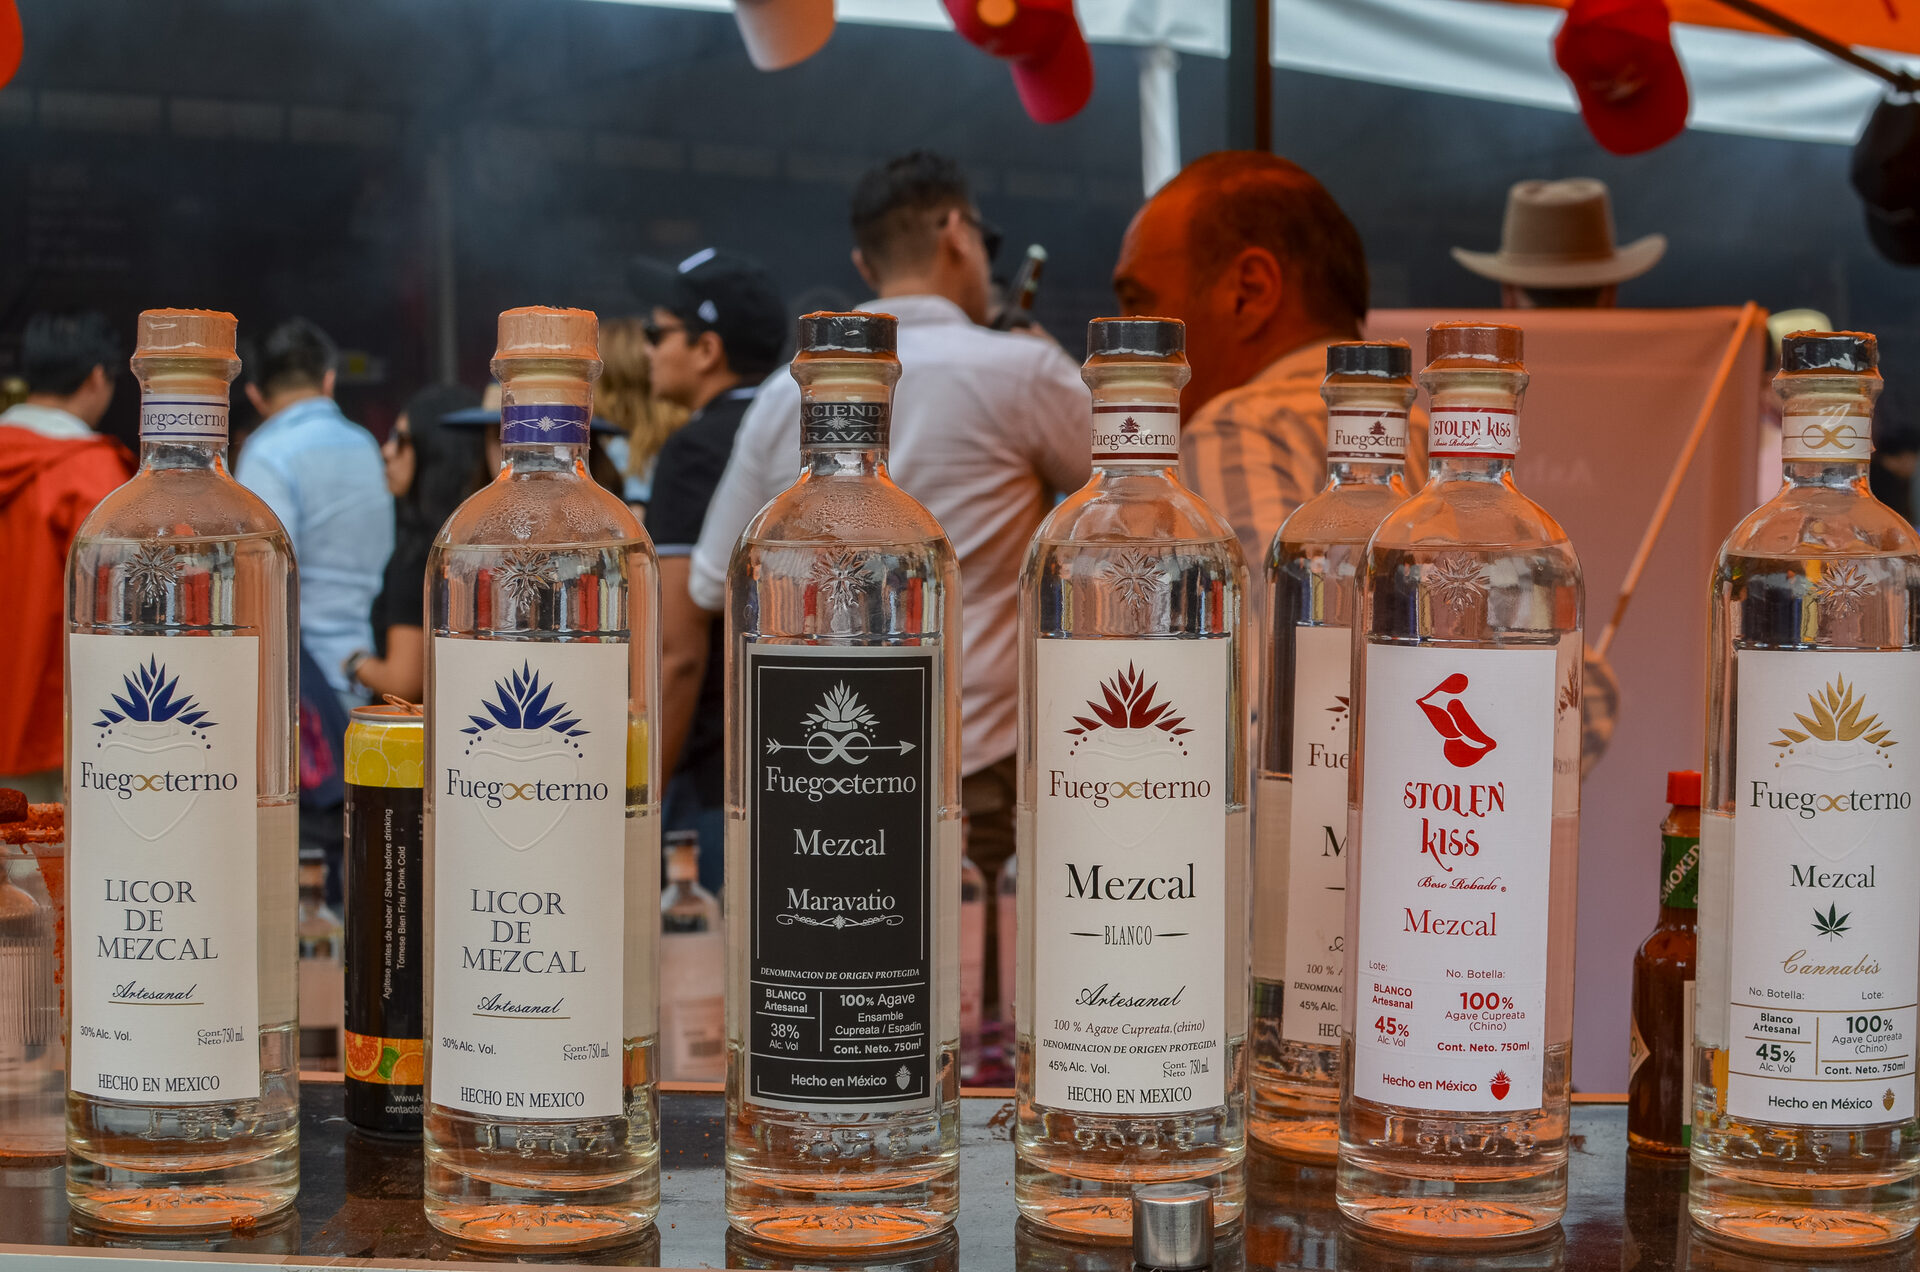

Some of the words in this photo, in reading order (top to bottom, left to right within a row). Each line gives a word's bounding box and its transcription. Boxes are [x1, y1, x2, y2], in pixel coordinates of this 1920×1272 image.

[1434, 419, 1481, 439] STOLEN
[1403, 781, 1505, 818] STOLEN
[384, 808, 394, 841] drinking
[793, 828, 886, 856] Mezcal
[384, 843, 393, 870] before
[397, 846, 406, 866] Cold
[384, 871, 393, 898] Shake
[397, 867, 406, 889] Drink
[1064, 862, 1197, 901] Mezcal
[1417, 875, 1448, 890] Beso
[1449, 876, 1502, 891] Robado
[1789, 864, 1876, 889] Mezcal
[104, 879, 197, 903] LICOR
[786, 887, 896, 911] Maravatio
[470, 888, 566, 915] LICOR
[124, 909, 163, 932] DE
[384, 904, 393, 929] beber
[397, 915, 406, 934] Bien
[1403, 907, 1497, 937] Mezcal
[384, 930, 393, 941] de
[490, 919, 532, 944] DE
[1104, 925, 1153, 946] BLANCO
[97, 935, 219, 961] MEZCAL
[384, 943, 393, 967] antes
[462, 945, 587, 974] MEZCAL
[1369, 960, 1388, 972] Lote:
[1780, 949, 1882, 976] Cannabis
[760, 967, 823, 980] DENOMINACION
[825, 971, 838, 980] DE
[839, 971, 874, 980] ORIGEN
[875, 968, 920, 979] PROTEGIDA
[1446, 969, 1464, 979] No.
[1467, 969, 1506, 980] Botella:
[112, 980, 198, 1000] Artesanal
[766, 989, 807, 1001] BLANCO
[839, 993, 875, 1007] 100%
[877, 993, 916, 1009] Agave
[1075, 983, 1186, 1008] Artesanal
[1373, 983, 1413, 997] BLANCO
[1459, 992, 1514, 1011] 100%
[1749, 987, 1764, 997] No.
[1767, 989, 1805, 1000] Botella:
[1861, 991, 1884, 1000] Lote:
[476, 993, 565, 1014] Artesanal
[764, 1001, 808, 1013] Artesanal
[857, 1011, 904, 1023] Ensamble
[1320, 1001, 1339, 1012] Alc.
[1372, 995, 1414, 1010] Artesanal
[1445, 1011, 1478, 1022] Agave
[1481, 1011, 1526, 1021] Cupreata
[770, 1022, 800, 1039] 38%
[834, 1025, 880, 1037] Cupreata
[1054, 1019, 1070, 1031] 100
[1085, 1022, 1119, 1038] Agave
[1374, 1015, 1410, 1038] 45%
[1469, 1021, 1507, 1032] (Chino)
[1760, 1012, 1794, 1024] Blanco
[1846, 1015, 1894, 1034] 100%
[114, 1030, 132, 1042] Vol.
[197, 1029, 223, 1038] Cont.
[197, 1037, 222, 1046] Neto
[1752, 1023, 1801, 1035] Artesanal
[1832, 1035, 1863, 1045] Agave
[1865, 1032, 1903, 1044] Cupreata
[478, 1043, 497, 1055] Vol.
[563, 1043, 588, 1053] Cont.
[784, 1040, 799, 1051] Vol
[833, 1044, 862, 1055] Cont.
[866, 1043, 892, 1054] Neto.
[1042, 1038, 1112, 1054] DENOMINACION
[1113, 1045, 1127, 1054] DE
[1129, 1045, 1168, 1054] ORIGEN
[1168, 1039, 1217, 1053] PROTEGIDA
[1392, 1037, 1406, 1048] Vol
[1437, 1042, 1466, 1052] Cont.
[1469, 1042, 1497, 1052] Neto.
[1500, 1041, 1530, 1052] 750ml
[1755, 1043, 1796, 1063] 45%
[1854, 1043, 1888, 1055] (Chino)
[563, 1052, 588, 1062] Neto
[1162, 1061, 1187, 1070] Cont.
[1090, 1063, 1111, 1074] Vol.
[1162, 1069, 1186, 1078] Neto
[1758, 1062, 1776, 1073] Alc.
[1777, 1063, 1792, 1073] Vol
[1824, 1066, 1852, 1076] Cont.
[1855, 1065, 1880, 1075] Neto.
[1882, 1061, 1906, 1073] 750ml
[98, 1073, 139, 1092] HECHO
[142, 1077, 161, 1093] EN
[165, 1075, 220, 1093] MEXICO
[791, 1074, 828, 1086] Hecho
[829, 1077, 845, 1087] en
[847, 1073, 887, 1087] México
[1382, 1073, 1416, 1088] Hecho
[1418, 1079, 1433, 1090] en
[1435, 1078, 1478, 1092] México
[460, 1086, 502, 1106] HECHO
[506, 1092, 524, 1107] EN
[529, 1091, 585, 1108] MEXICO
[1067, 1085, 1112, 1104] HECHO
[1116, 1089, 1136, 1104] EN
[1139, 1086, 1192, 1104] MEXICO
[1768, 1095, 1809, 1109] Hecho
[1812, 1099, 1828, 1110] en
[1831, 1097, 1873, 1110] México
